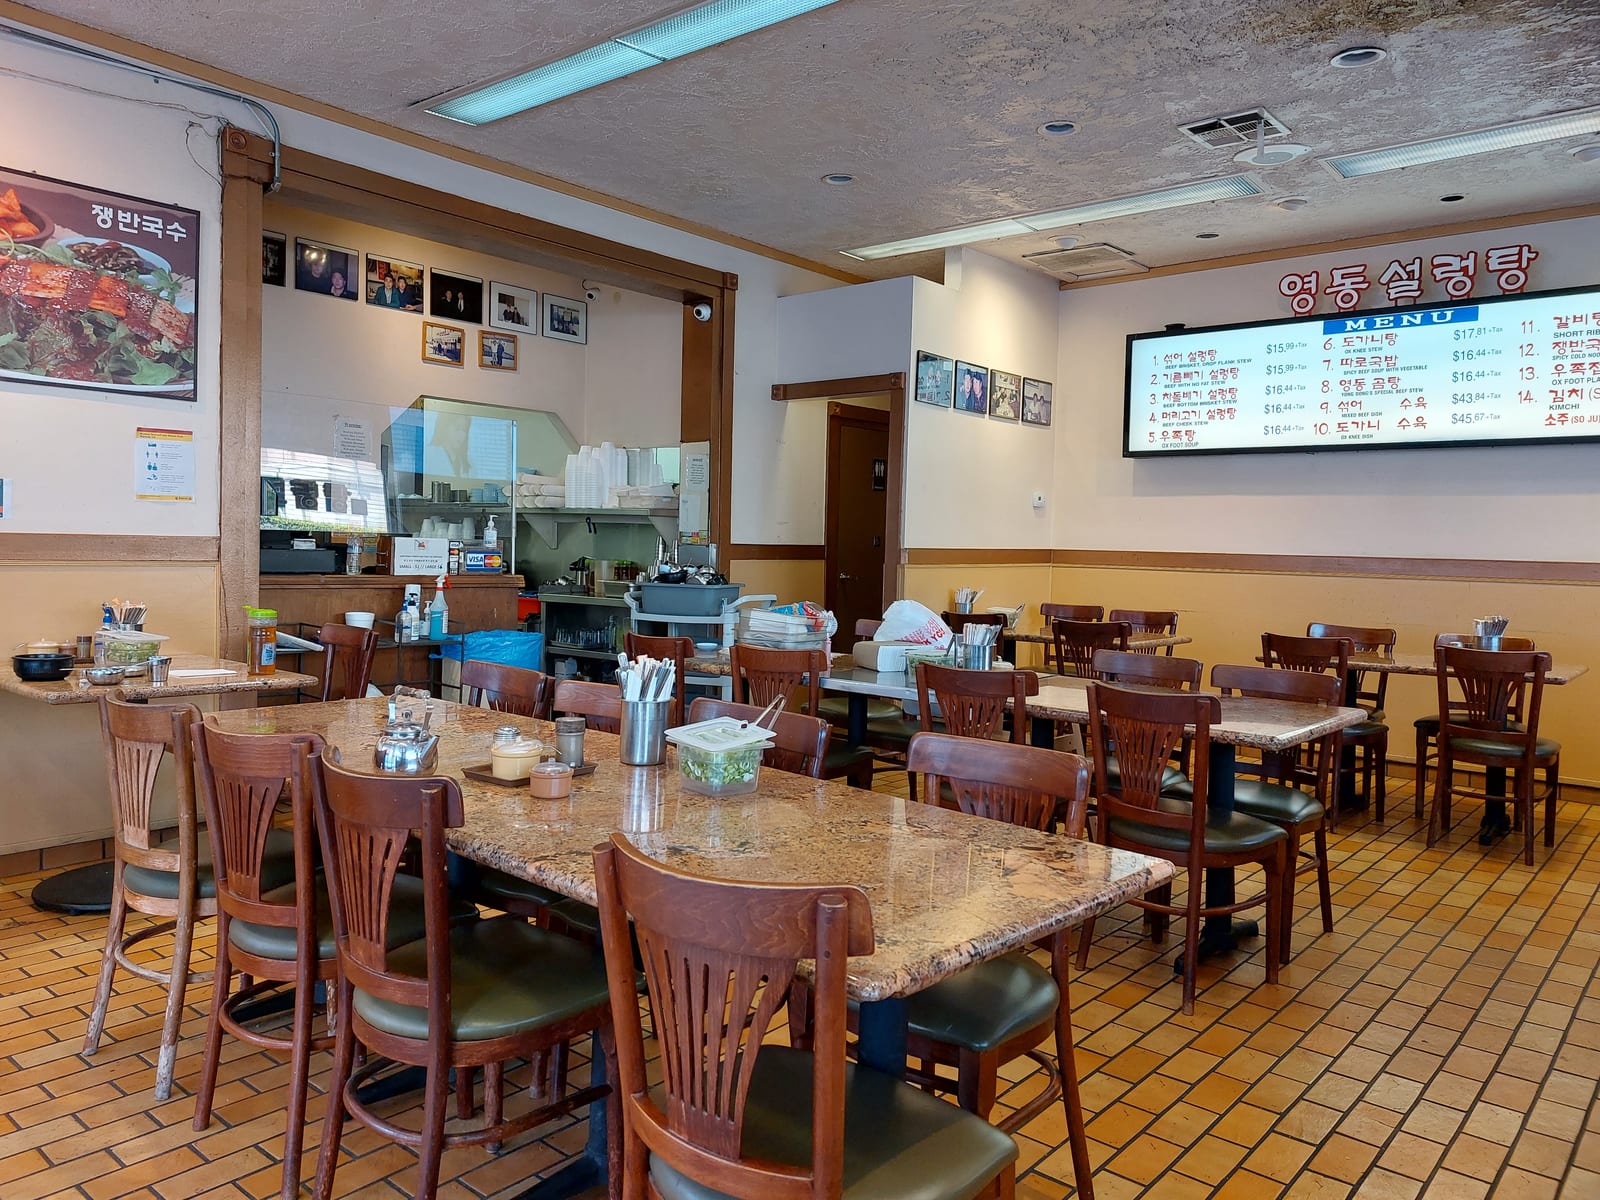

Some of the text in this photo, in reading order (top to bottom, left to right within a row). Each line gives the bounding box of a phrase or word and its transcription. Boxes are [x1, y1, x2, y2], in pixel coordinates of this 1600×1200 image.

[91, 204, 187, 242] 쟁반국수
[1344, 310, 1454, 332] MENU
[1522, 320, 1540, 334] 11.
[1323, 333, 1398, 351] 6. 도가니탕
[1164, 353, 1182, 364] 섞어
[1188, 350, 1217, 362] 설렁탕
[1520, 344, 1539, 357] 12.
[1323, 355, 1398, 371] 7. 따로국밥
[1151, 374, 1160, 385] 2.
[1209, 368, 1240, 380] 설렁탕
[1519, 367, 1539, 380] 13.
[1321, 376, 1401, 393] 8. 영동 곰탕
[1150, 393, 1158, 404] 3.
[1208, 388, 1238, 400] 설렁탕
[1518, 390, 1538, 404] 14.
[1549, 388, 1584, 403] 김치
[1320, 396, 1427, 414] 9. 섞어 수육
[1149, 408, 1237, 423] 4. 머리고기 설렁탕
[1545, 413, 1569, 426] 소주
[1314, 416, 1428, 435] 10. 도가니 수육
[1148, 432, 1157, 443] 5.
